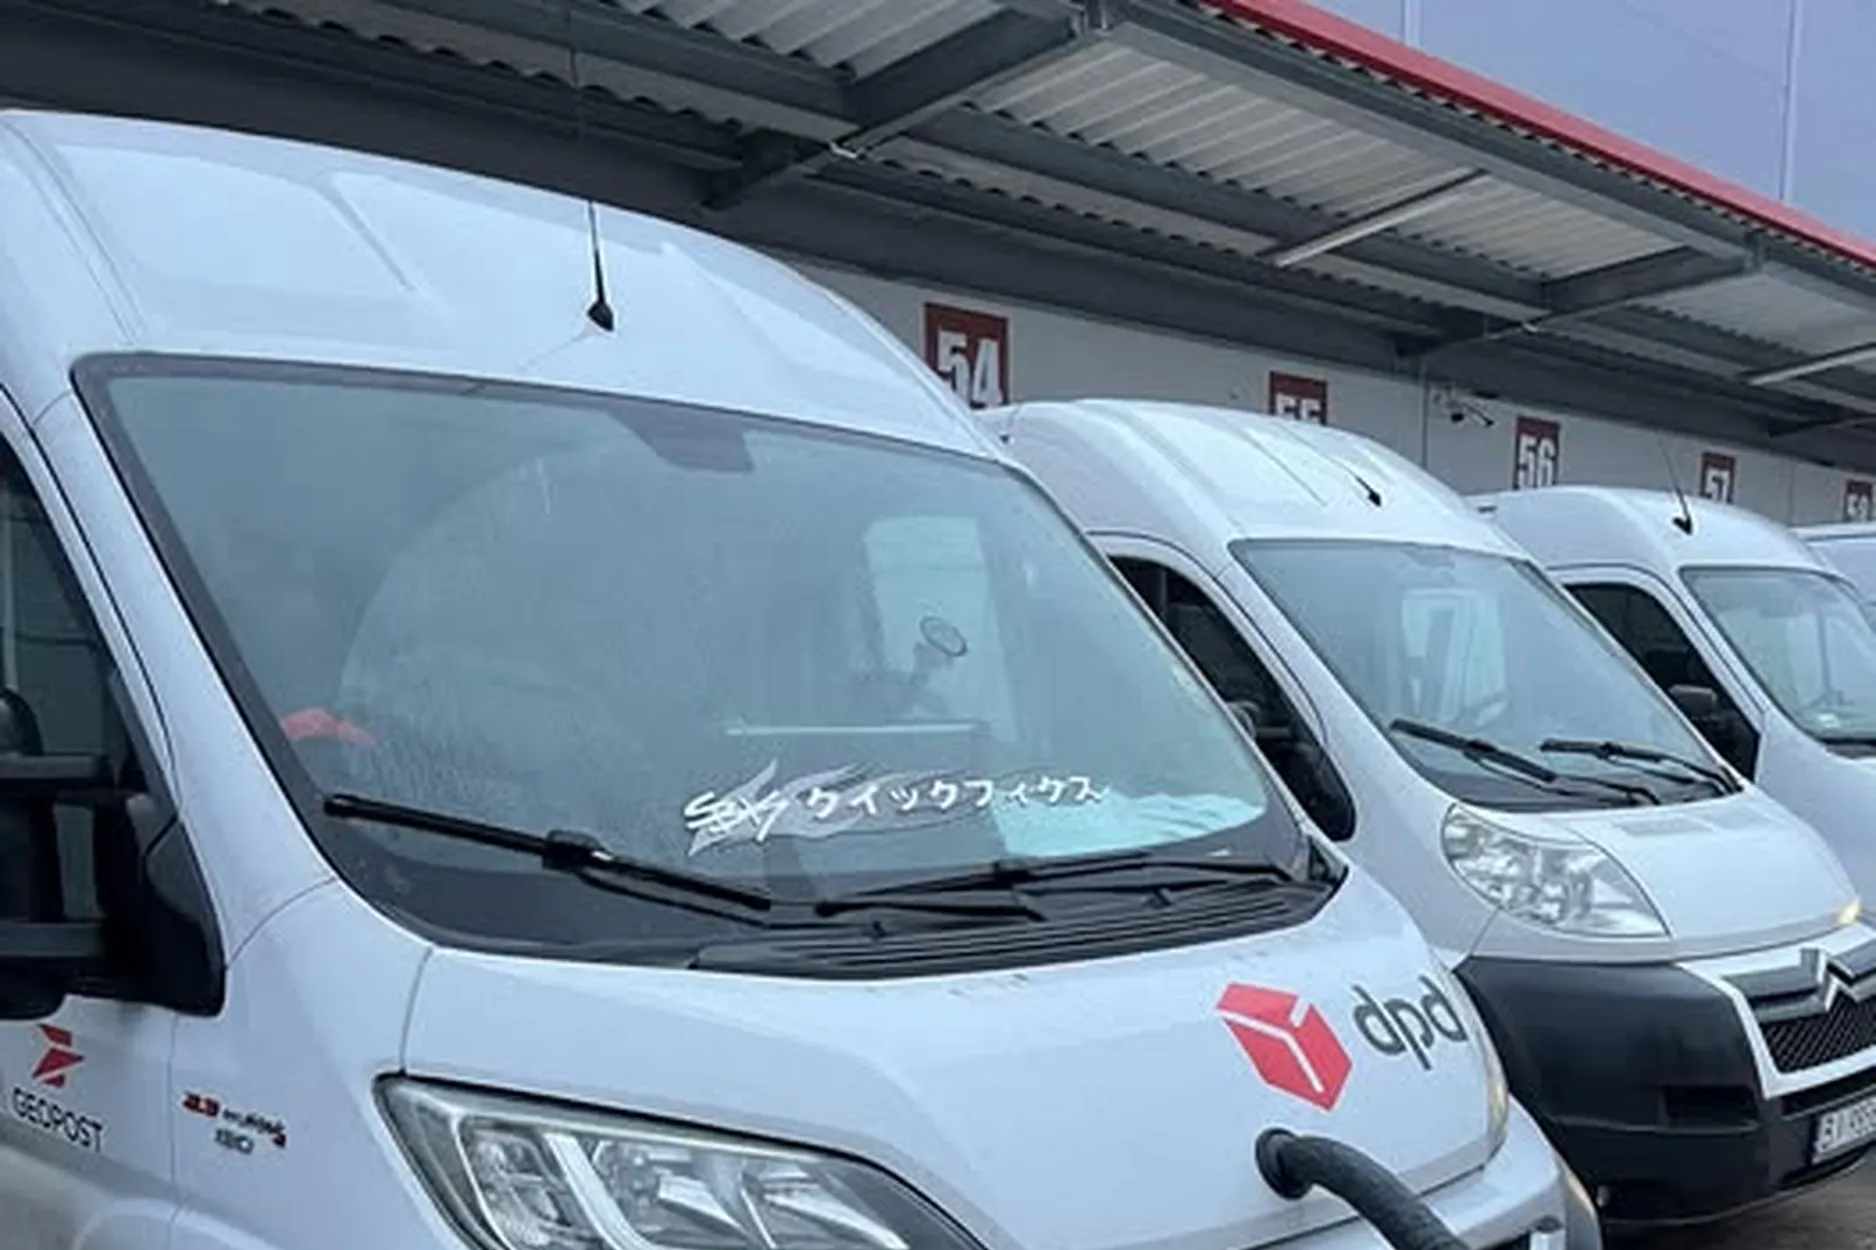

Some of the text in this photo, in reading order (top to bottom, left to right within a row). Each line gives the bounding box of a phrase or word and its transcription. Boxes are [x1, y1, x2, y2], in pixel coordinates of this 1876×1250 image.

[937, 329, 1004, 408] 54
[1518, 433, 1556, 488] 56
[1351, 974, 1469, 1071] dpd
[13, 1086, 103, 1152] GEOPOST
